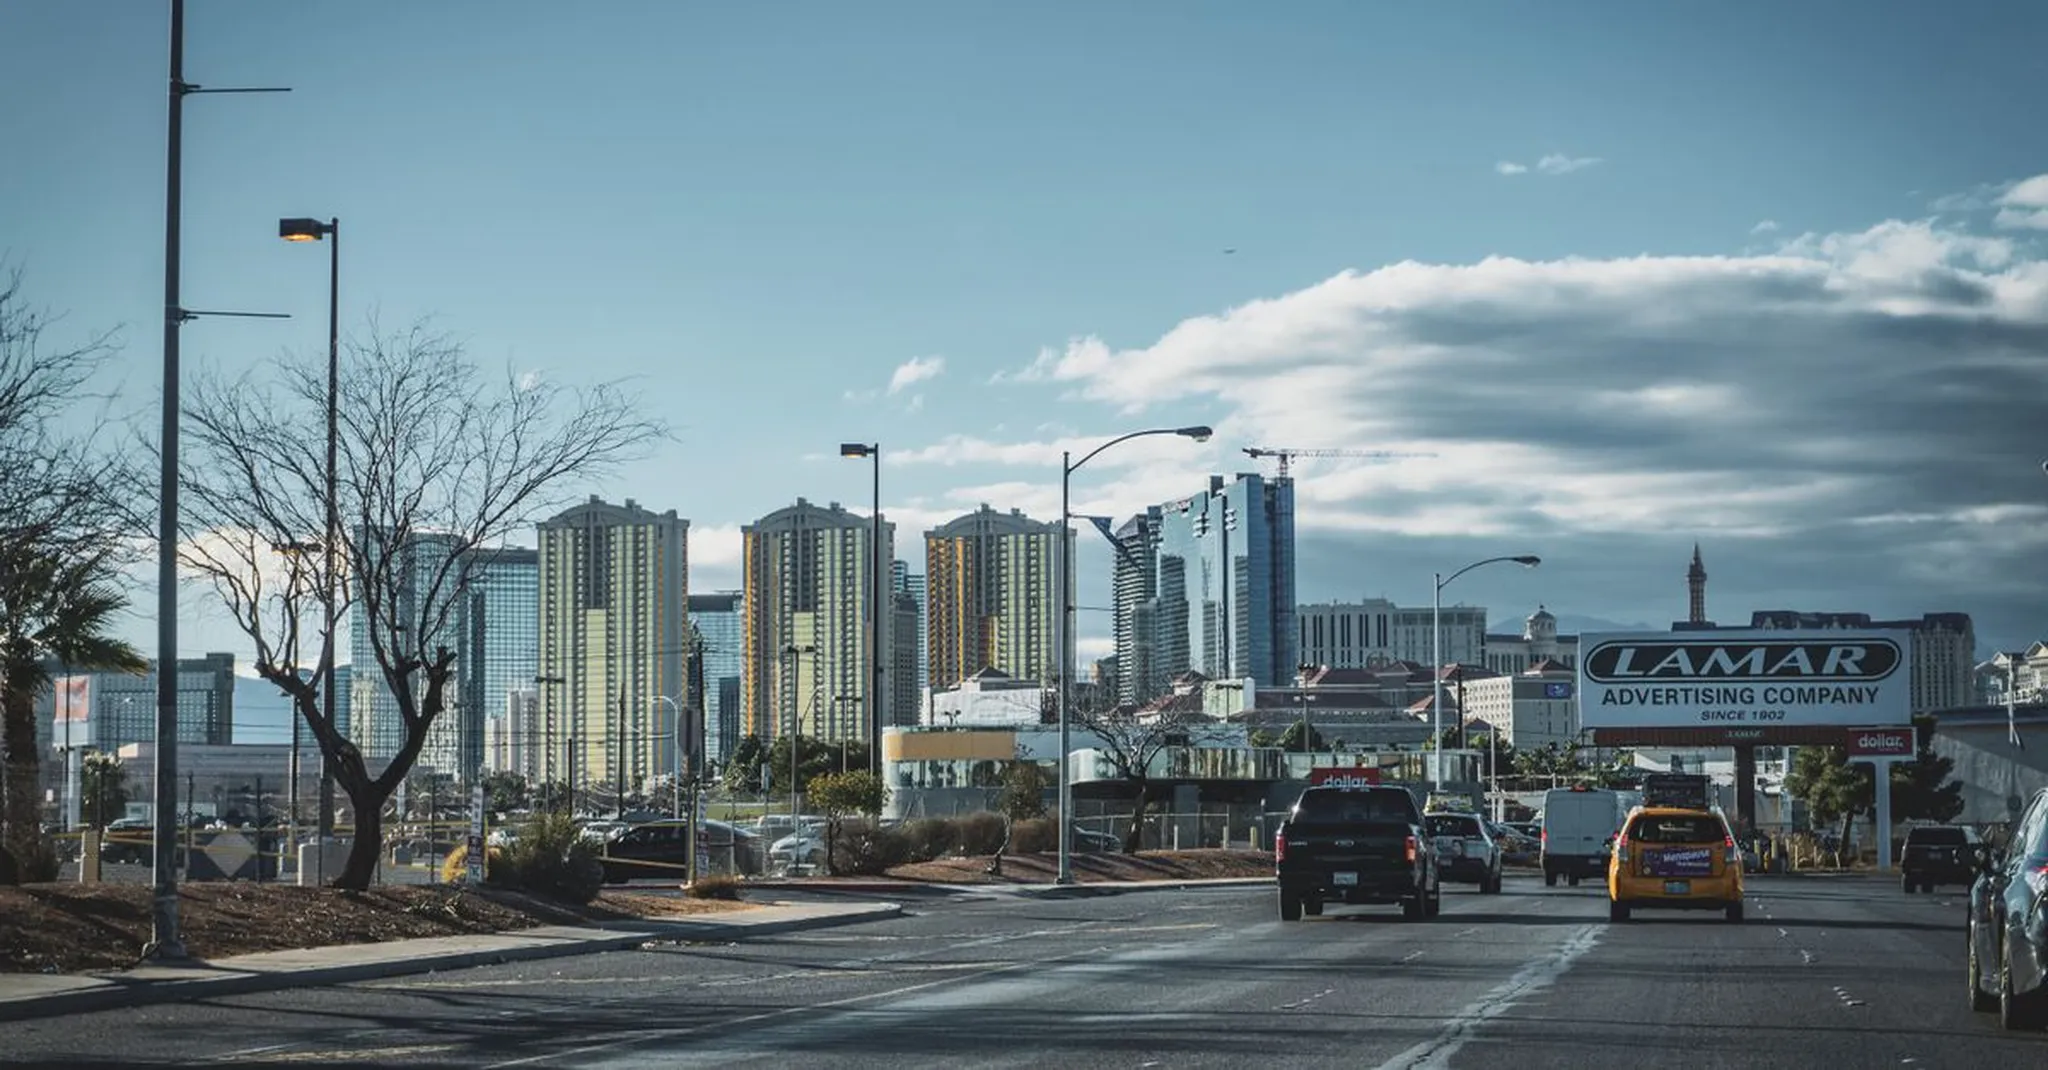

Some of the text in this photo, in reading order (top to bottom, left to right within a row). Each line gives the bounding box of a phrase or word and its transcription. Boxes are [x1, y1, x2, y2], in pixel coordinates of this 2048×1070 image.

[1612, 647, 1867, 675] LAMAR
[1602, 686, 1880, 705] ADVERTISING COMPANY
[1700, 710, 1786, 721] SINCE 1902
